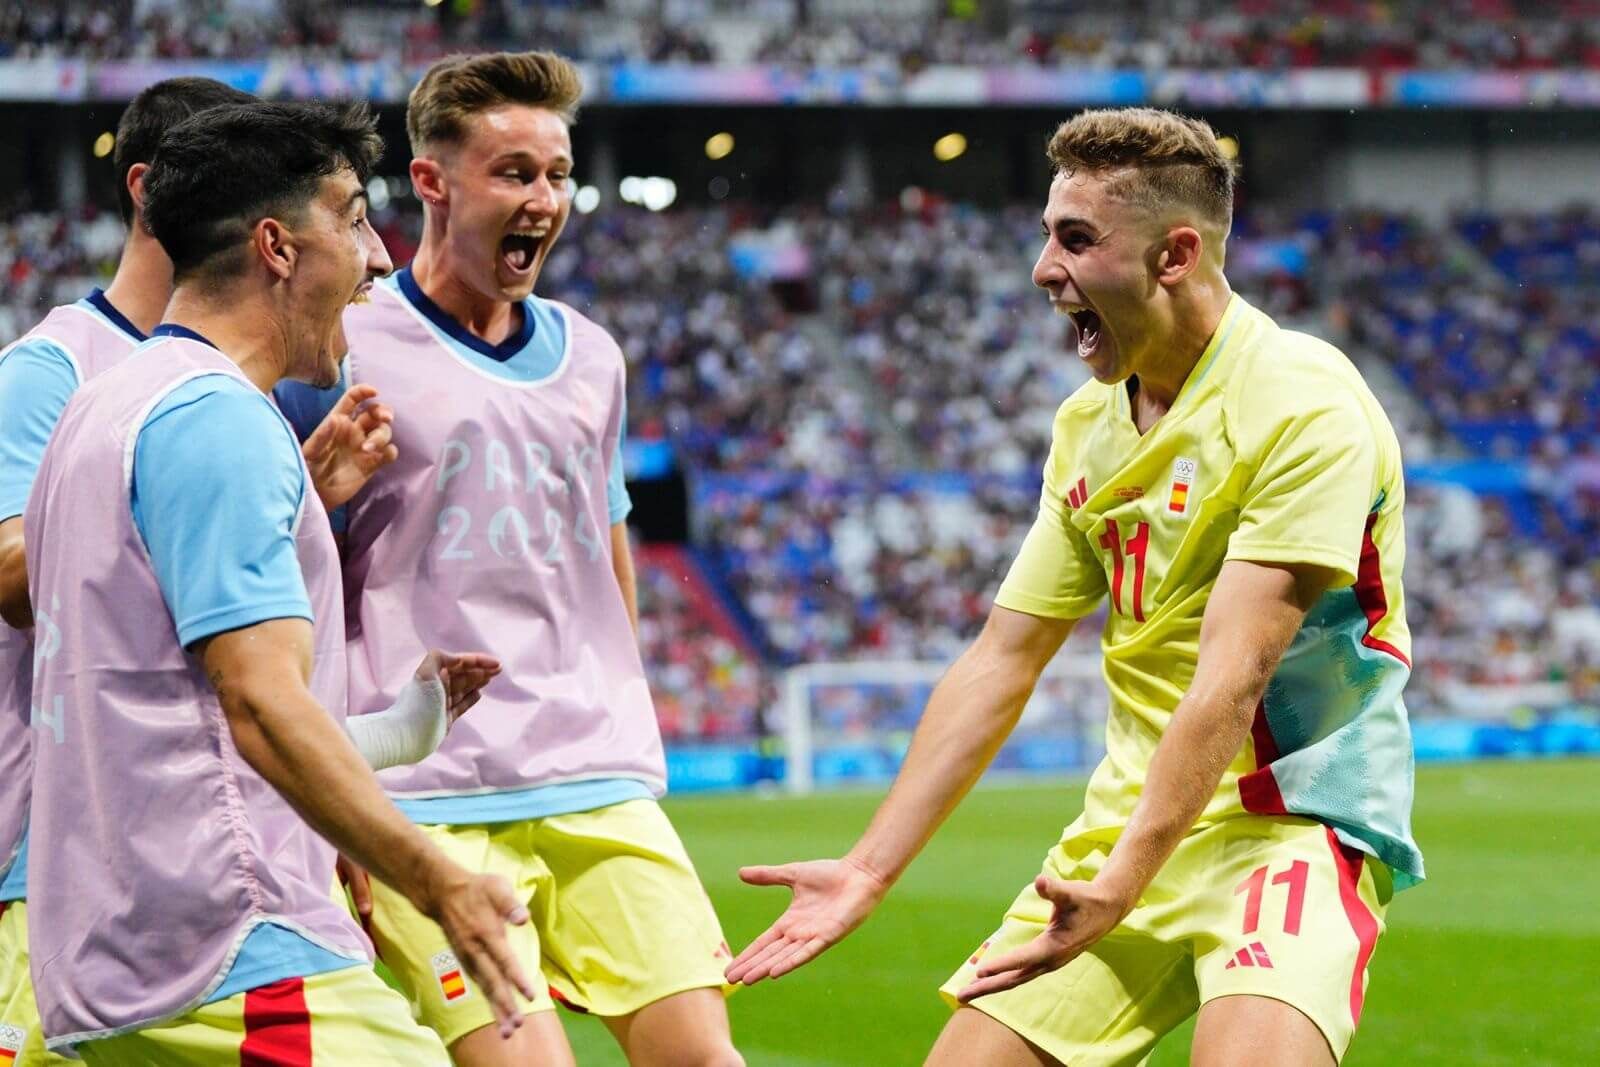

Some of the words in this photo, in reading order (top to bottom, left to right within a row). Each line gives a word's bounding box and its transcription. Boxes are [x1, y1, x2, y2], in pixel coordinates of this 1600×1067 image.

[437, 505, 601, 561] 2024
[1098, 517, 1149, 623] 11
[1234, 859, 1310, 936] 11
